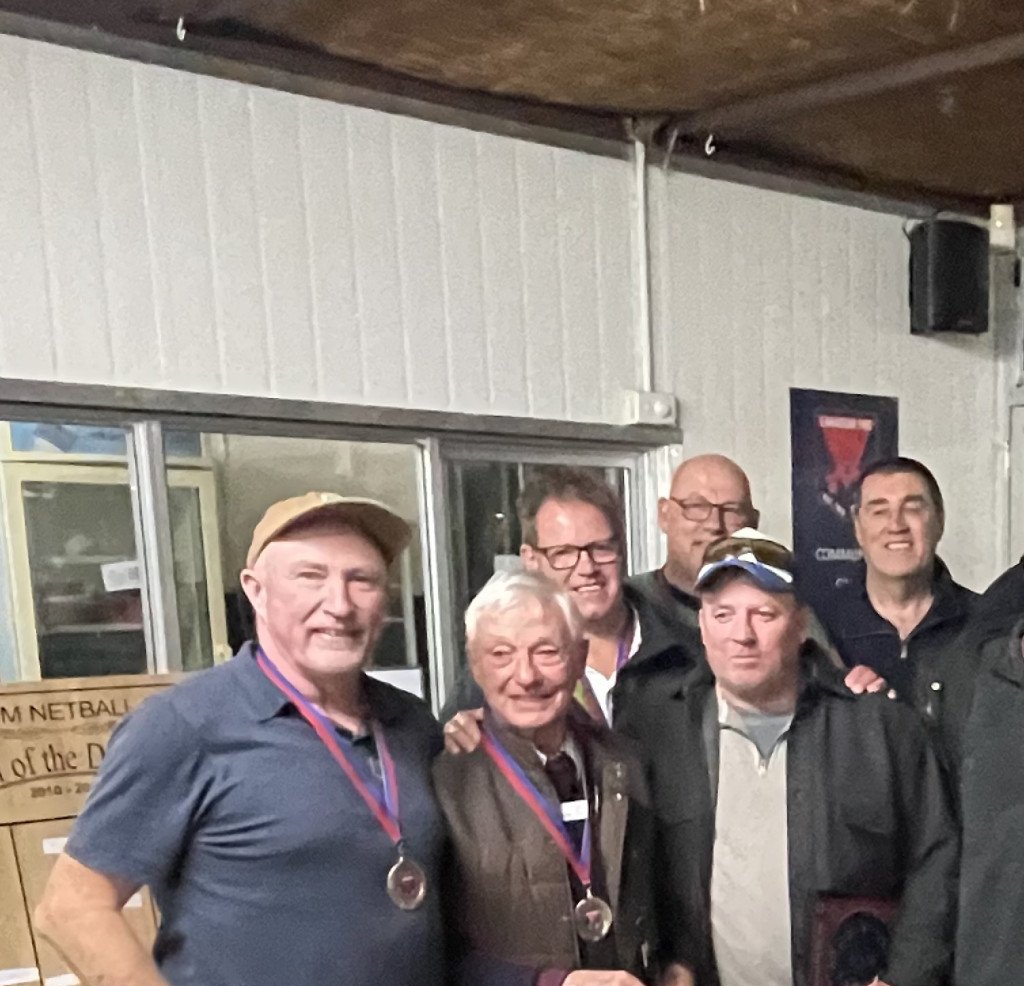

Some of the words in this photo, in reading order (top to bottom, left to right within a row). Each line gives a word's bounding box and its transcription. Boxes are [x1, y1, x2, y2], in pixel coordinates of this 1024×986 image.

[29, 699, 129, 720] NETBALL
[11, 746, 36, 778] of
[42, 744, 78, 772] the
